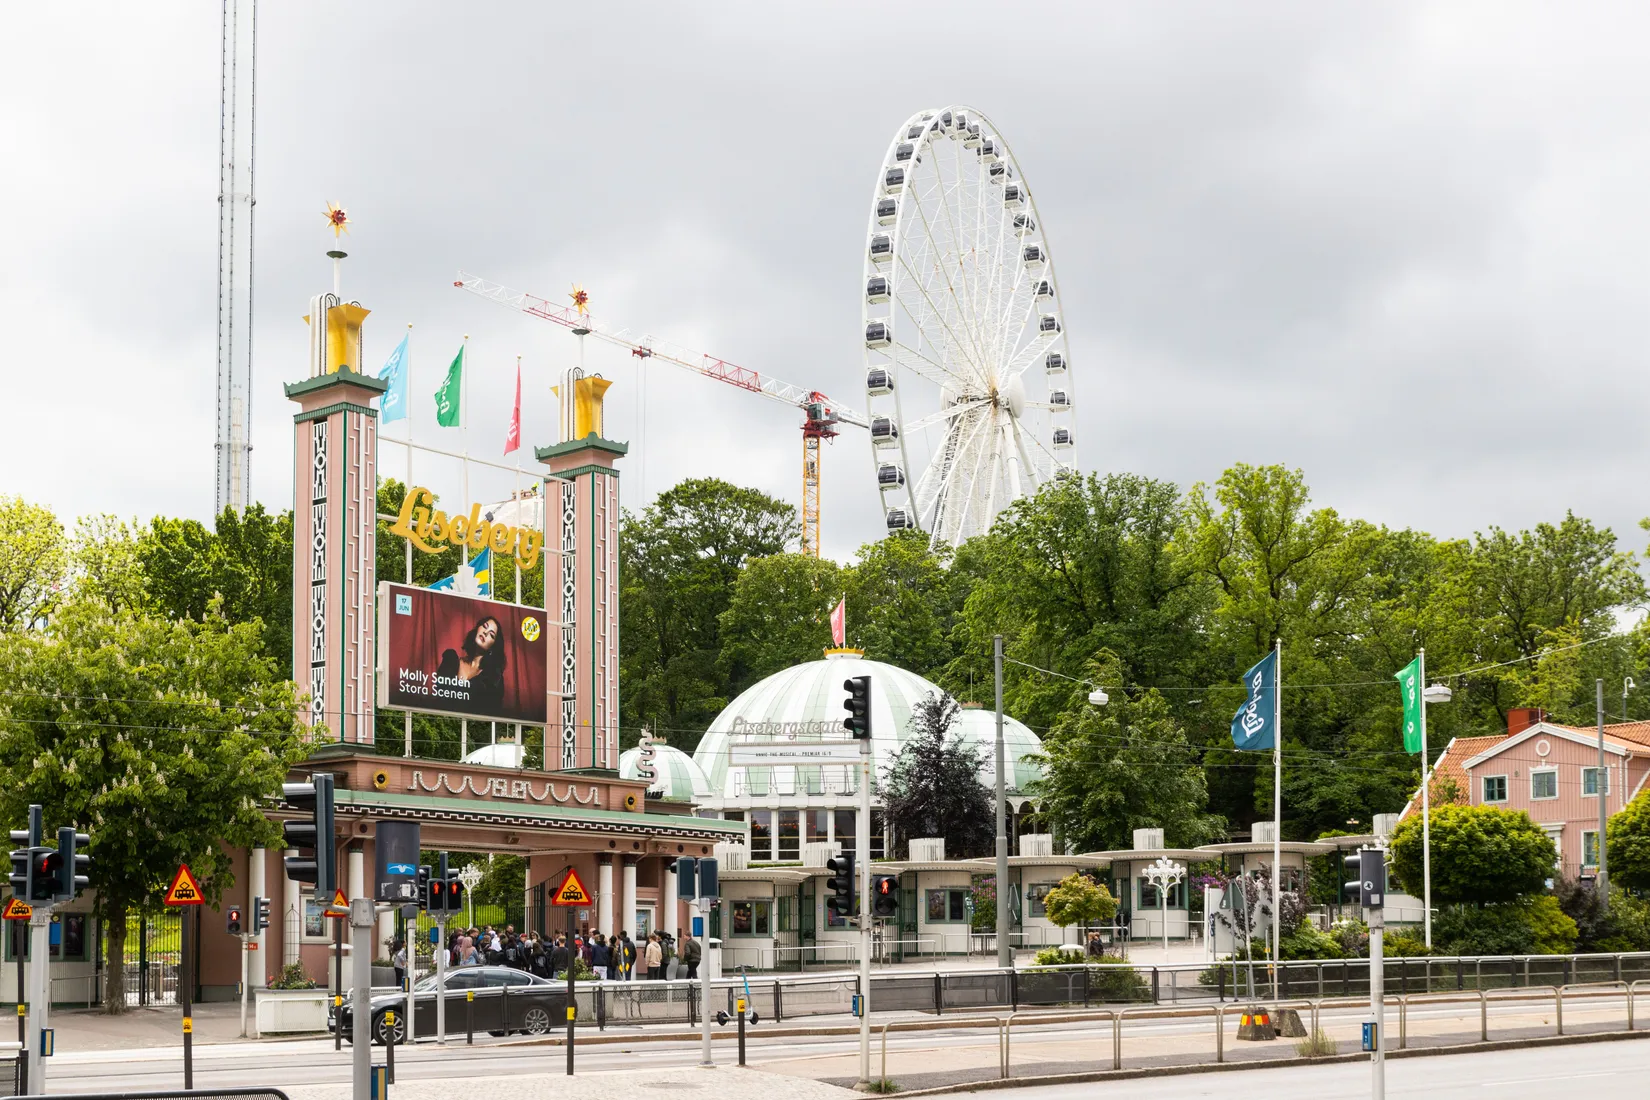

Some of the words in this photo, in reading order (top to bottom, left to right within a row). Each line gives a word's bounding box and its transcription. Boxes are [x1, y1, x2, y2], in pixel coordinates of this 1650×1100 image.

[389, 487, 543, 570] Liseberg
[399, 668, 429, 686] Molly
[431, 672, 471, 689] Sandén
[399, 680, 429, 696] Stora
[431, 685, 470, 701] Scenen
